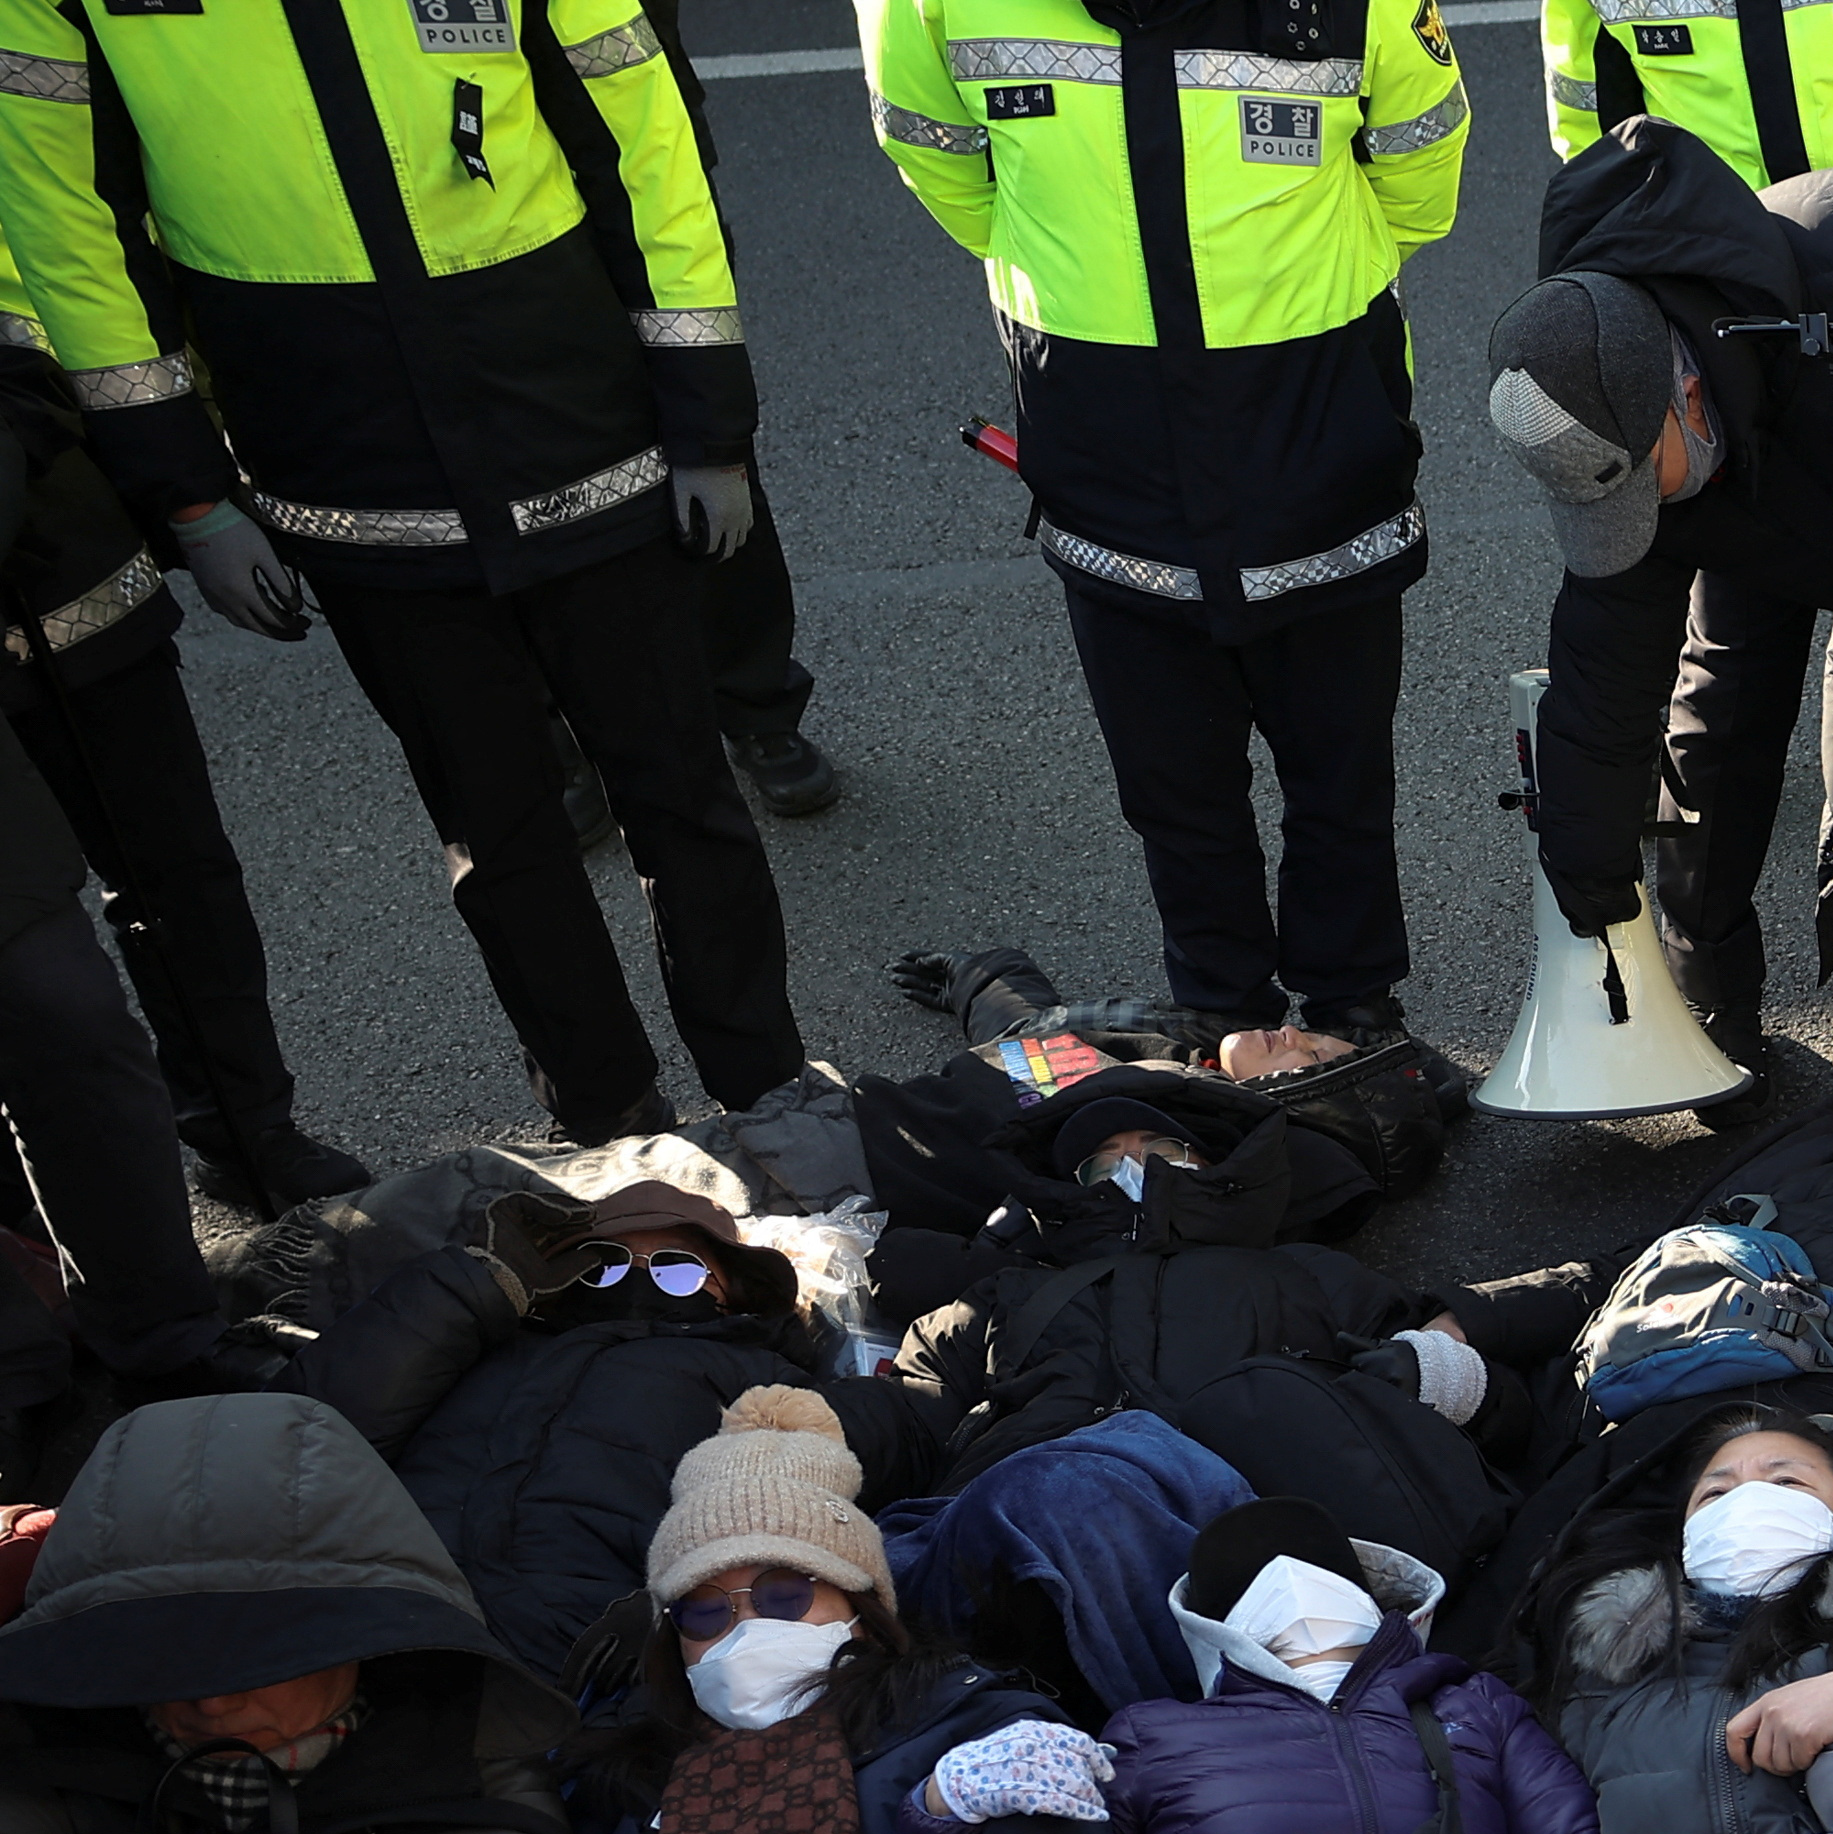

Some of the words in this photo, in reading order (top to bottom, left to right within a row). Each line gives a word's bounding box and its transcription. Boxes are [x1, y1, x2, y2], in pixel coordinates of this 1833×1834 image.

[426, 29, 506, 43] POLICE
[1249, 103, 1315, 138] 경찰
[1250, 140, 1314, 157] POLICE
